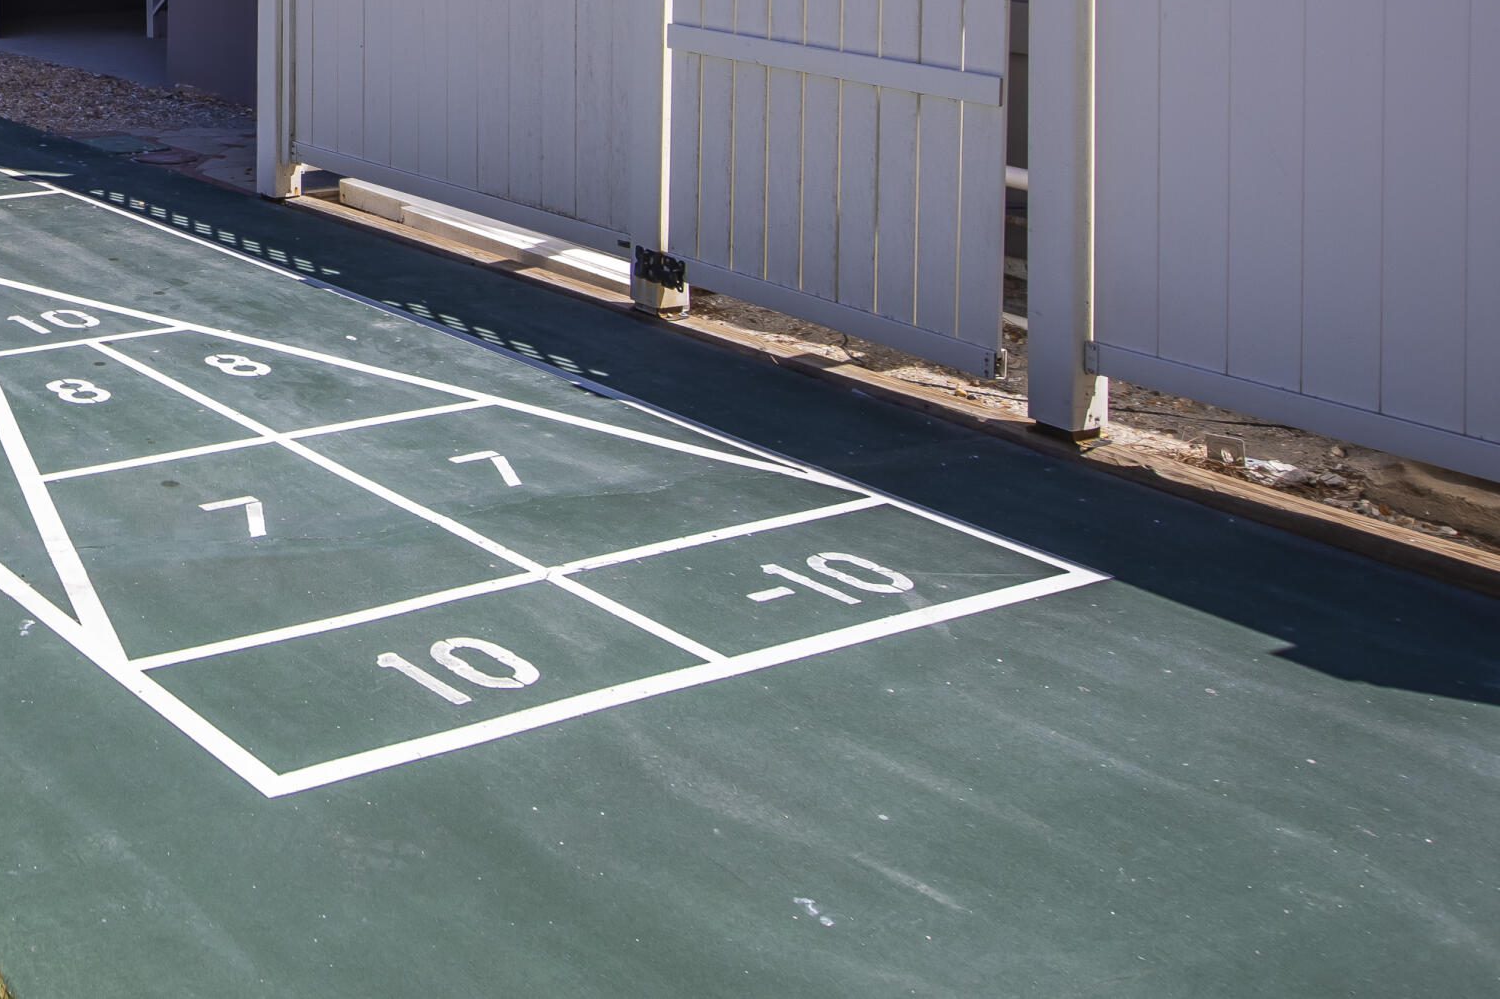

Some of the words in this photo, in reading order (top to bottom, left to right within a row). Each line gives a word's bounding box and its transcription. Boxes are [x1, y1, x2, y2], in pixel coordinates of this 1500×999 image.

[6, 309, 101, 335] 10
[202, 353, 273, 378] 8
[44, 377, 115, 405] 8
[448, 450, 523, 488] 7
[198, 495, 267, 540] 7
[746, 551, 916, 606] -10
[375, 636, 541, 706] 10
